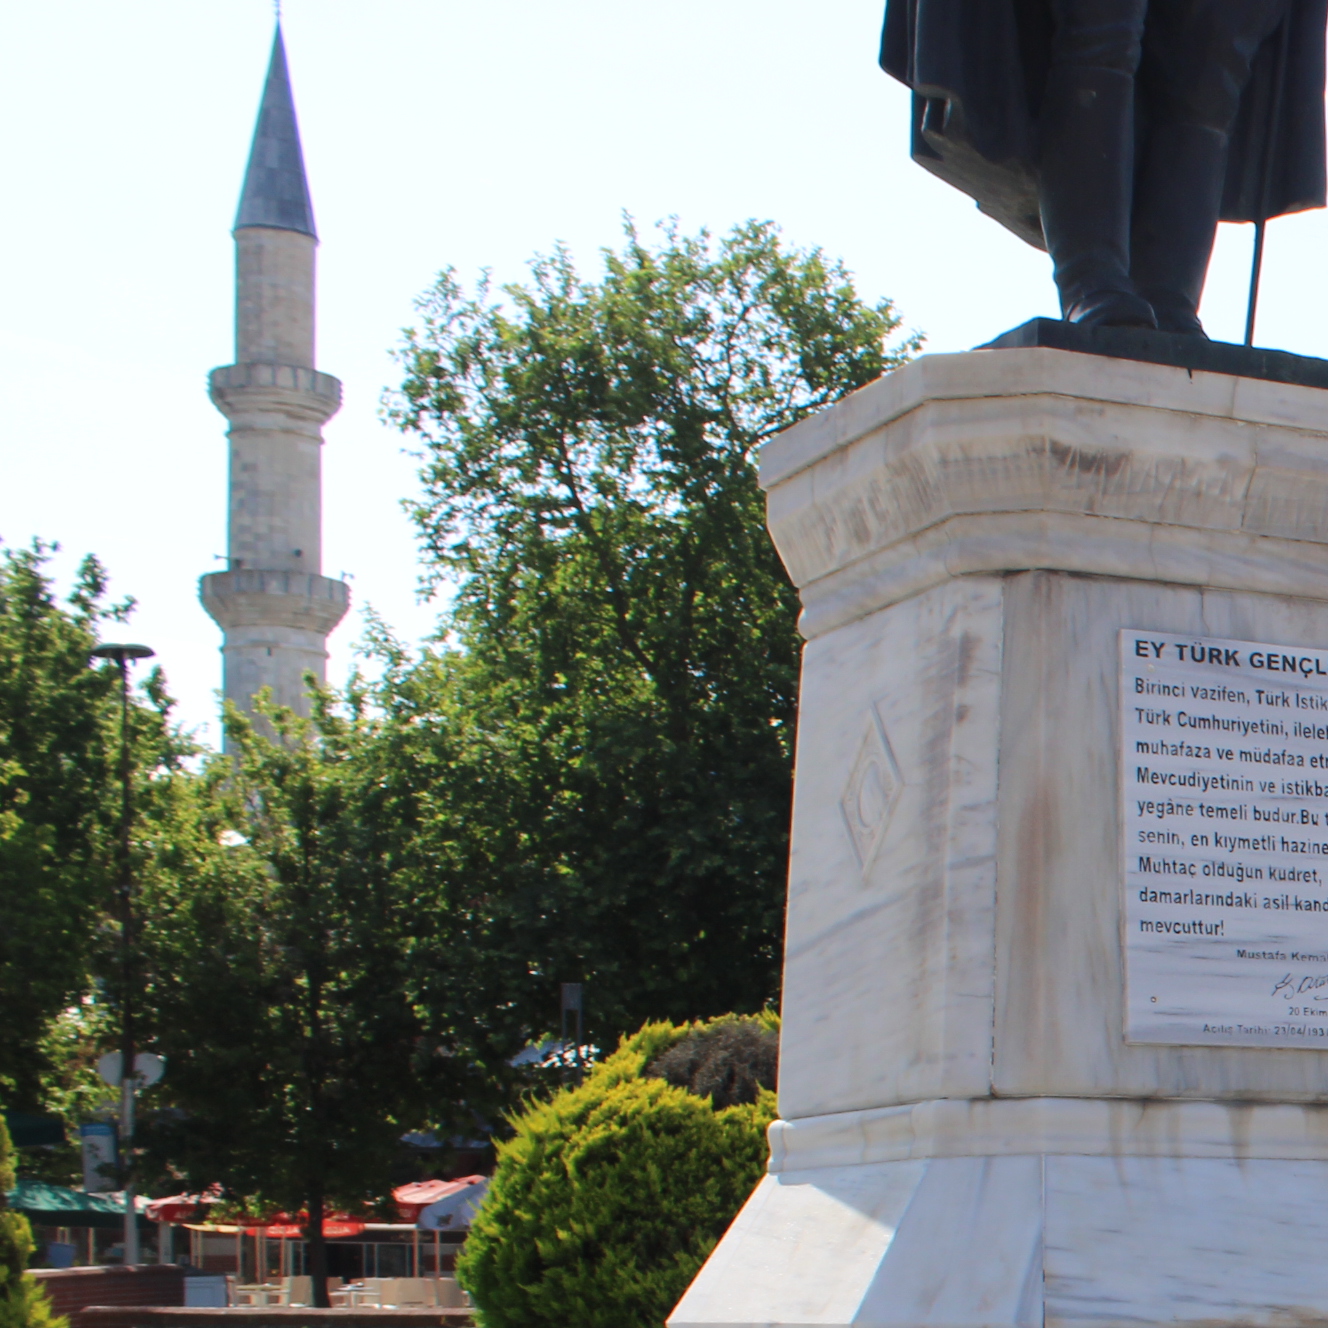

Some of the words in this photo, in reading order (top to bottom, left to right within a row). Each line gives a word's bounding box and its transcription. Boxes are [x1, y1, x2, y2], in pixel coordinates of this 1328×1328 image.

[1135, 639, 1166, 658] EY
[1175, 641, 1241, 667] TÜRK
[1135, 677, 1186, 698] Birinci
[1255, 689, 1290, 708] Türk
[1135, 707, 1171, 726] Türk
[1177, 711, 1289, 740] Cumhuriyetini,
[1136, 740, 1211, 759] muhafaza
[1217, 747, 1235, 761] ve
[1239, 747, 1304, 767] müdafaa
[1136, 766, 1254, 793] Mevcudiyetinin
[1259, 780, 1276, 794] ve
[1136, 798, 1194, 819] yegâne
[1199, 802, 1248, 821] temeli
[1138, 828, 1185, 849] senin,
[1191, 834, 1209, 847] en
[1214, 832, 1276, 853] kıymetli
[1139, 856, 1196, 878] Muhtaç
[1202, 860, 1263, 883] olduğun
[1269, 865, 1322, 887] kudret,
[1139, 886, 1258, 909] damarlarındaki
[1263, 894, 1289, 911] asil
[1140, 918, 1224, 937] mevcuttur!
[1236, 949, 1287, 961] Mustafa
[1288, 1006, 1300, 1016] 20
[1303, 1006, 1328, 1017] Ekim
